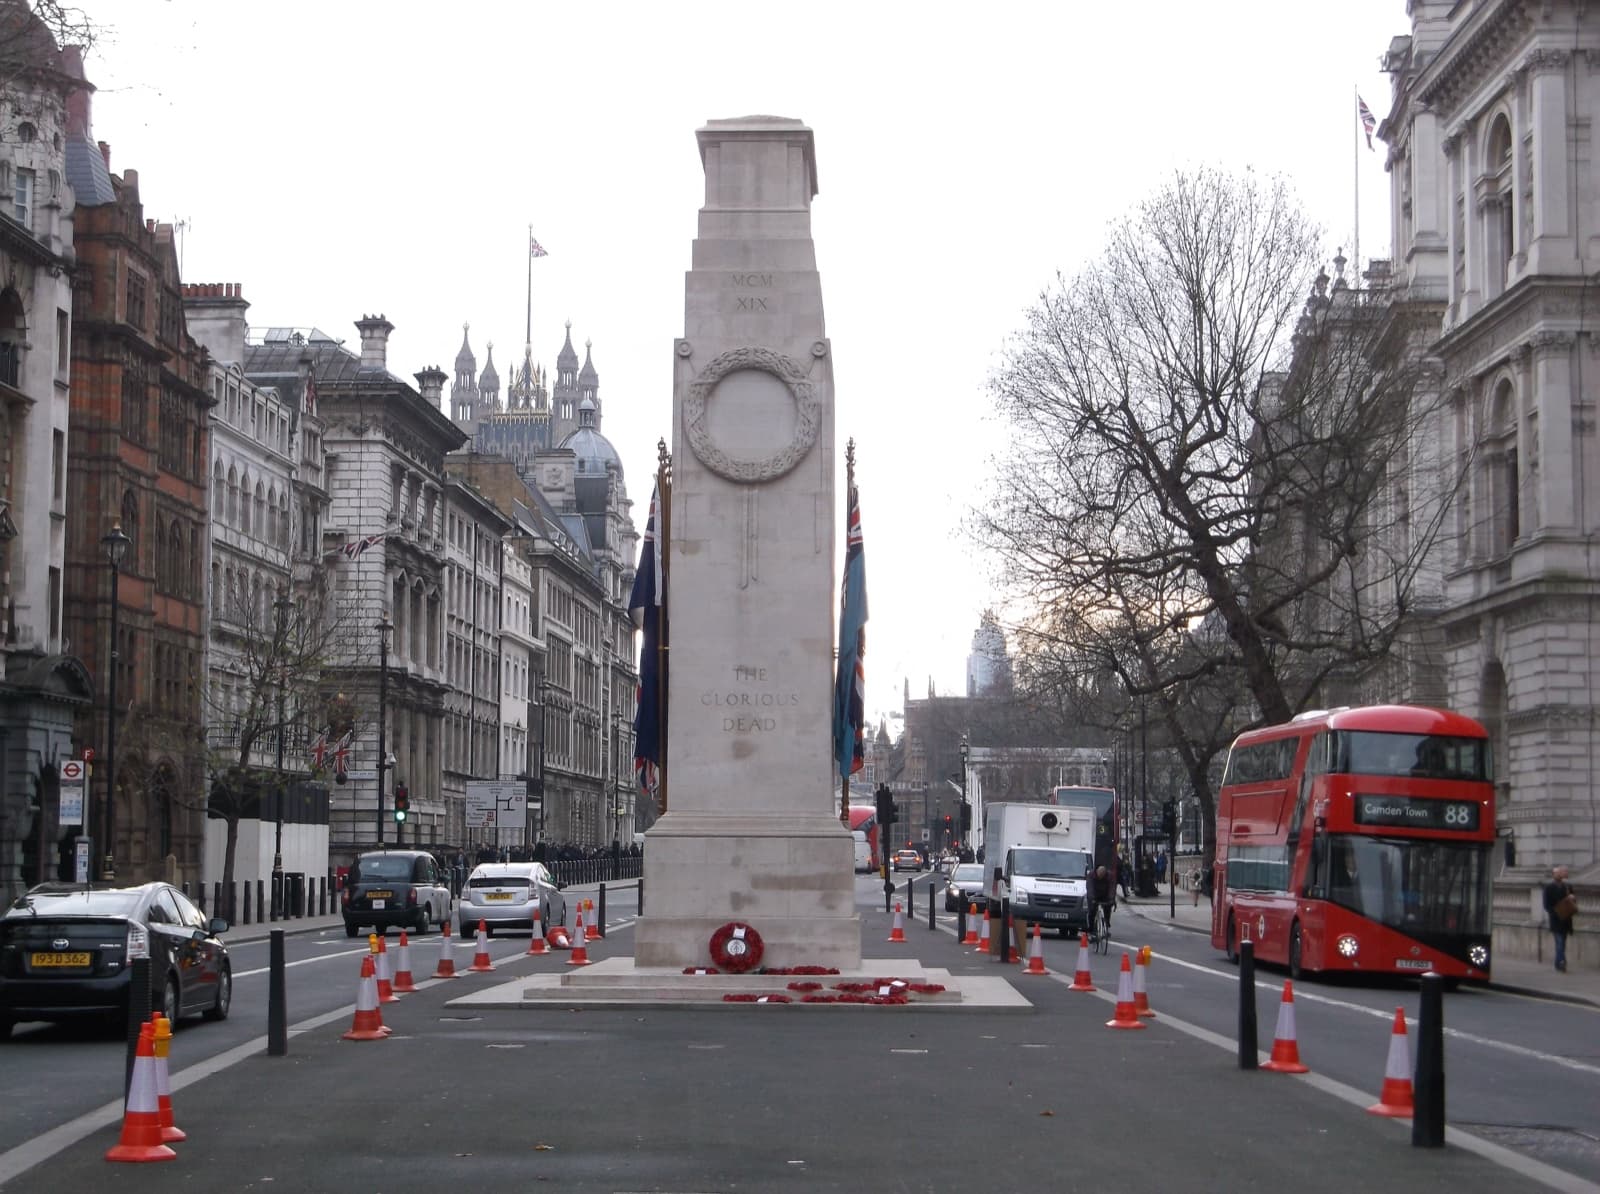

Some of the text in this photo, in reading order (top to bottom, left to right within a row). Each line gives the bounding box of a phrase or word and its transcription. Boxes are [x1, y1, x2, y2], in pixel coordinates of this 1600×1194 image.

[731, 273, 773, 288] MCM
[736, 297, 768, 311] XIX
[732, 666, 769, 681] THE
[700, 693, 800, 706] GLORIOUS
[723, 718, 776, 732] DEAD
[1364, 803, 1428, 817] Camden Town
[1445, 804, 1470, 825] 88
